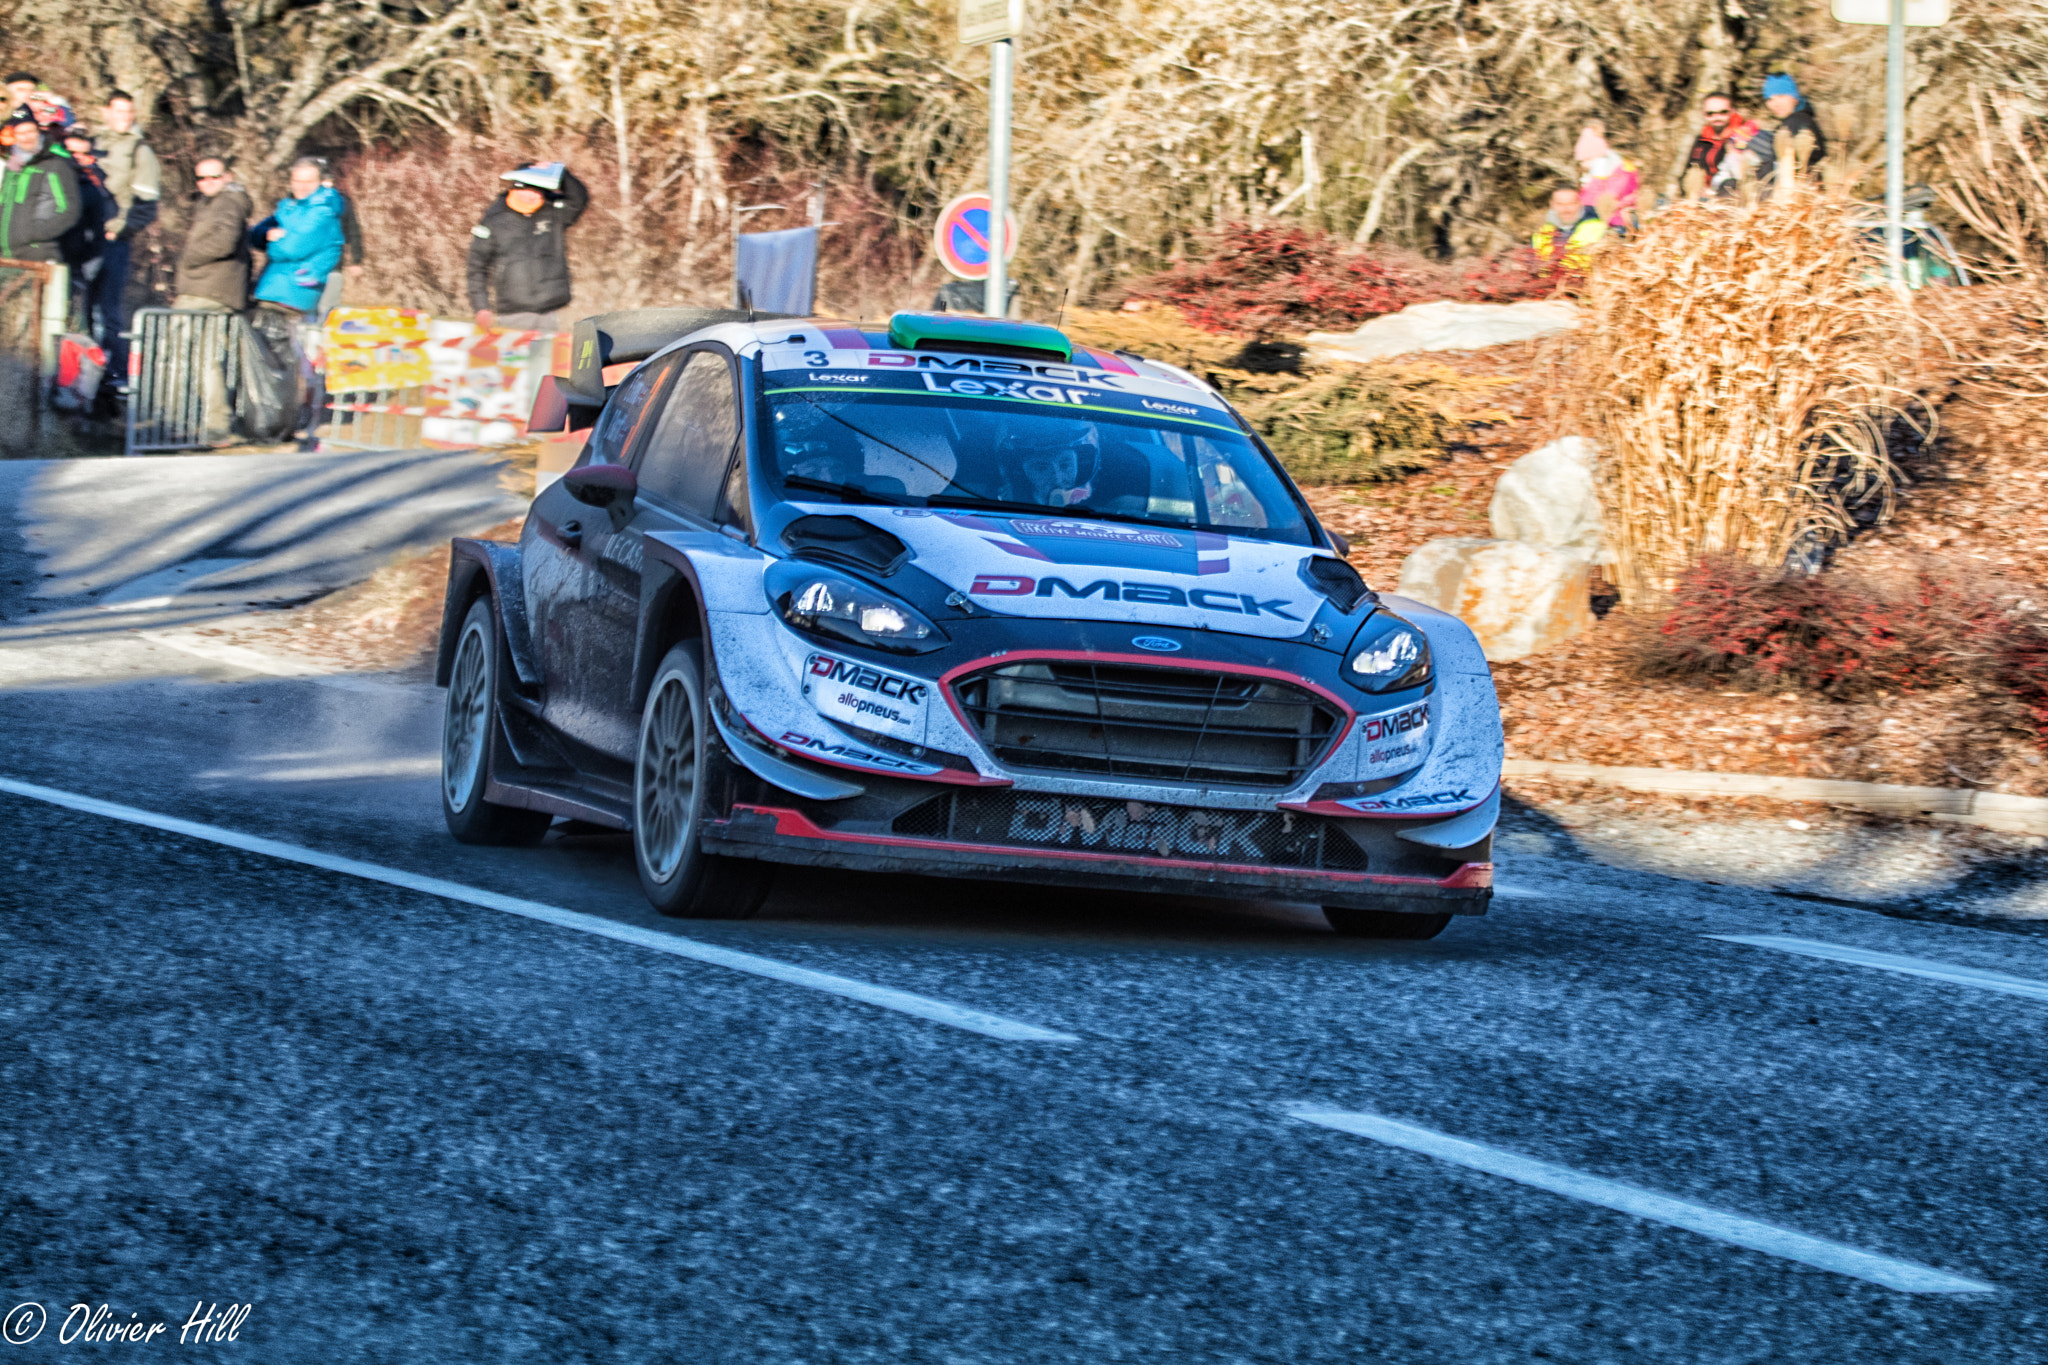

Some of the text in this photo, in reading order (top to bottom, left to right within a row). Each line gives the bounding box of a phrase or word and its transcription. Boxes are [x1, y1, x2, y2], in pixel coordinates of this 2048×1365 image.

[803, 350, 830, 368] 3
[809, 373, 869, 384] Lexar
[920, 373, 1092, 404] Lexar
[1141, 399, 1199, 416] Lexar
